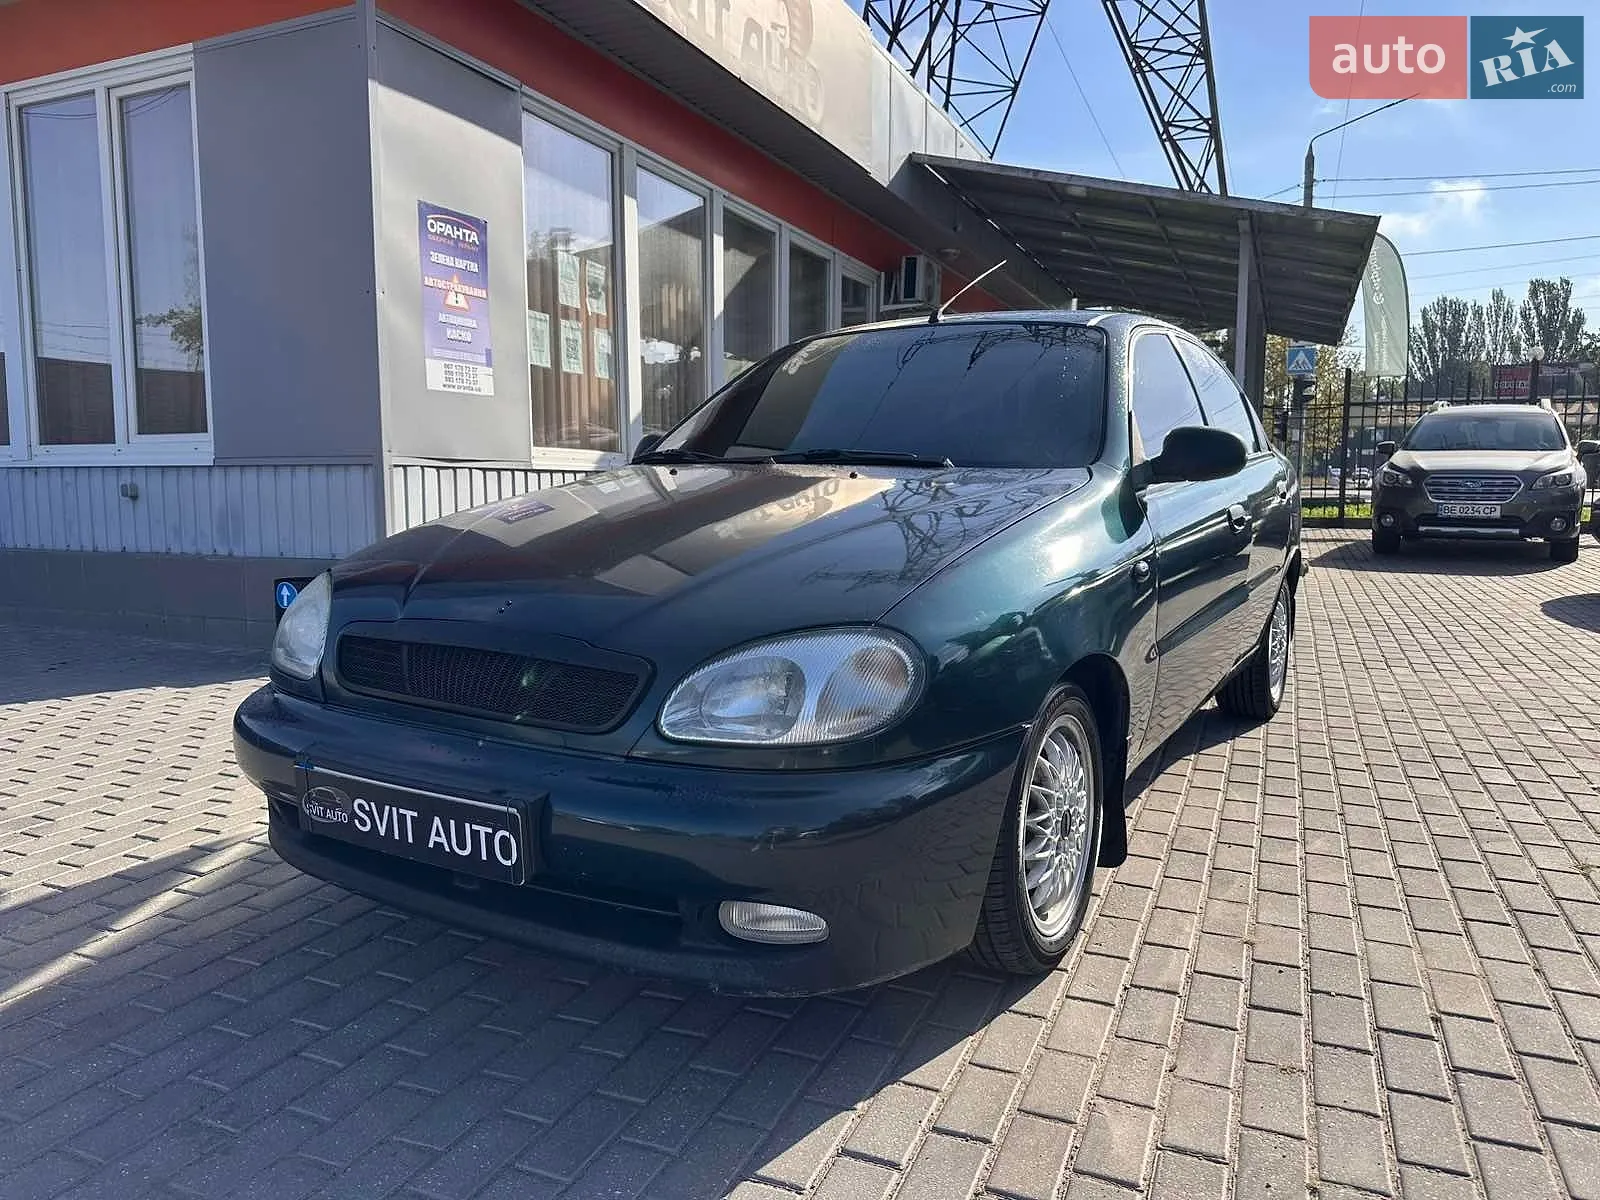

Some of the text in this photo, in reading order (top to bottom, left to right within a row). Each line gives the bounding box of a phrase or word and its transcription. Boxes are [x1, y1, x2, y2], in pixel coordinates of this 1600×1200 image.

[427, 219, 479, 245] ОРАНТА
[326, 808, 348, 823] AUTO
[353, 798, 518, 866] SVIT AUTO
